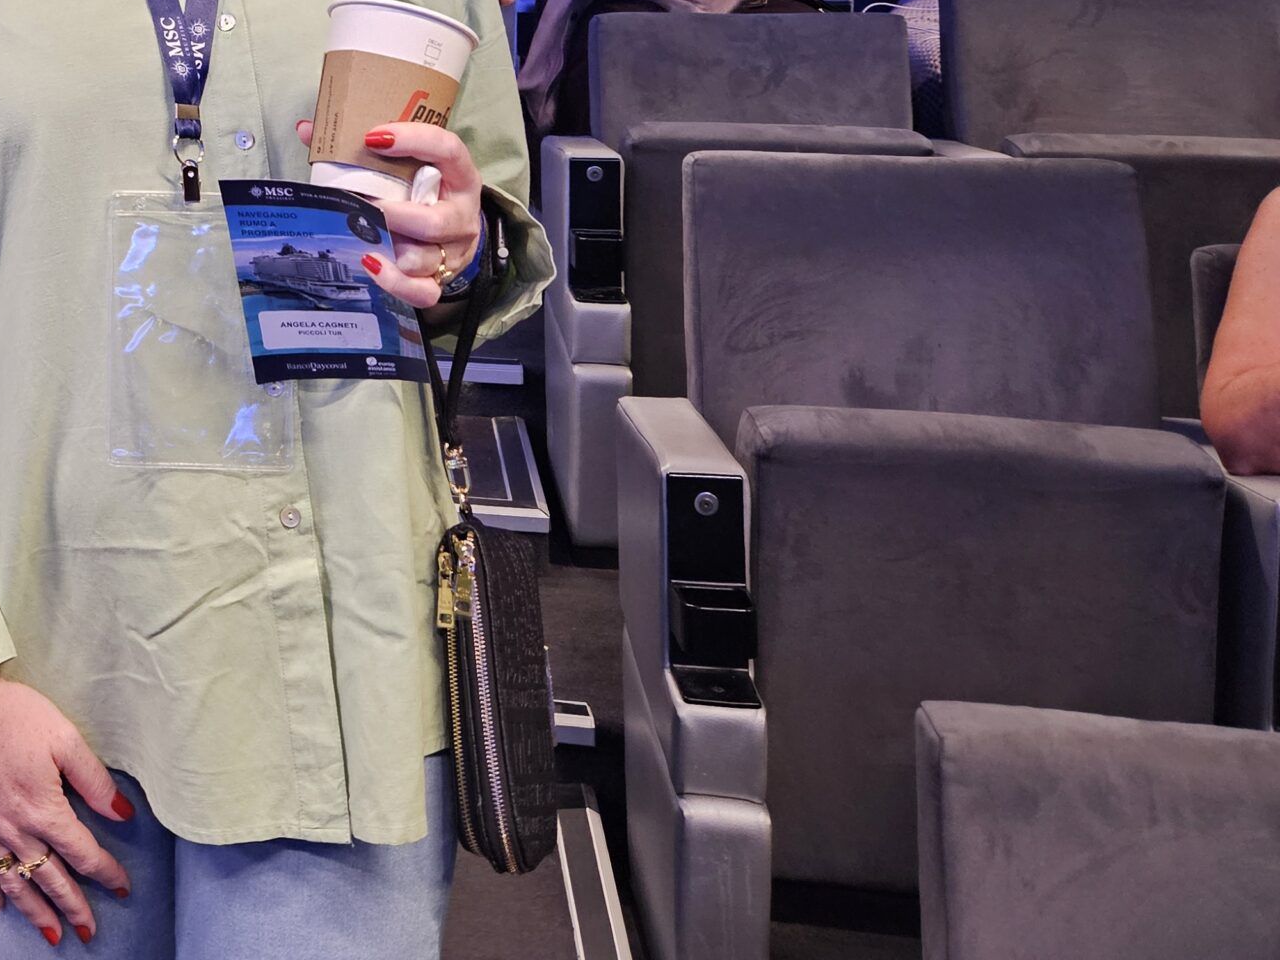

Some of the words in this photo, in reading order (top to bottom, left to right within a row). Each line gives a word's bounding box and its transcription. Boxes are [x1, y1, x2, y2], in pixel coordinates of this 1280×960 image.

[160, 16, 184, 57] MSC
[265, 187, 294, 197] MSC
[237, 210, 298, 220] NAVEGANDO
[239, 219, 267, 228] RUMO
[269, 220, 277, 228] A
[241, 229, 315, 239] PROSPERIDADE
[280, 321, 316, 329] ANGELA
[318, 321, 358, 329] CAGNETI
